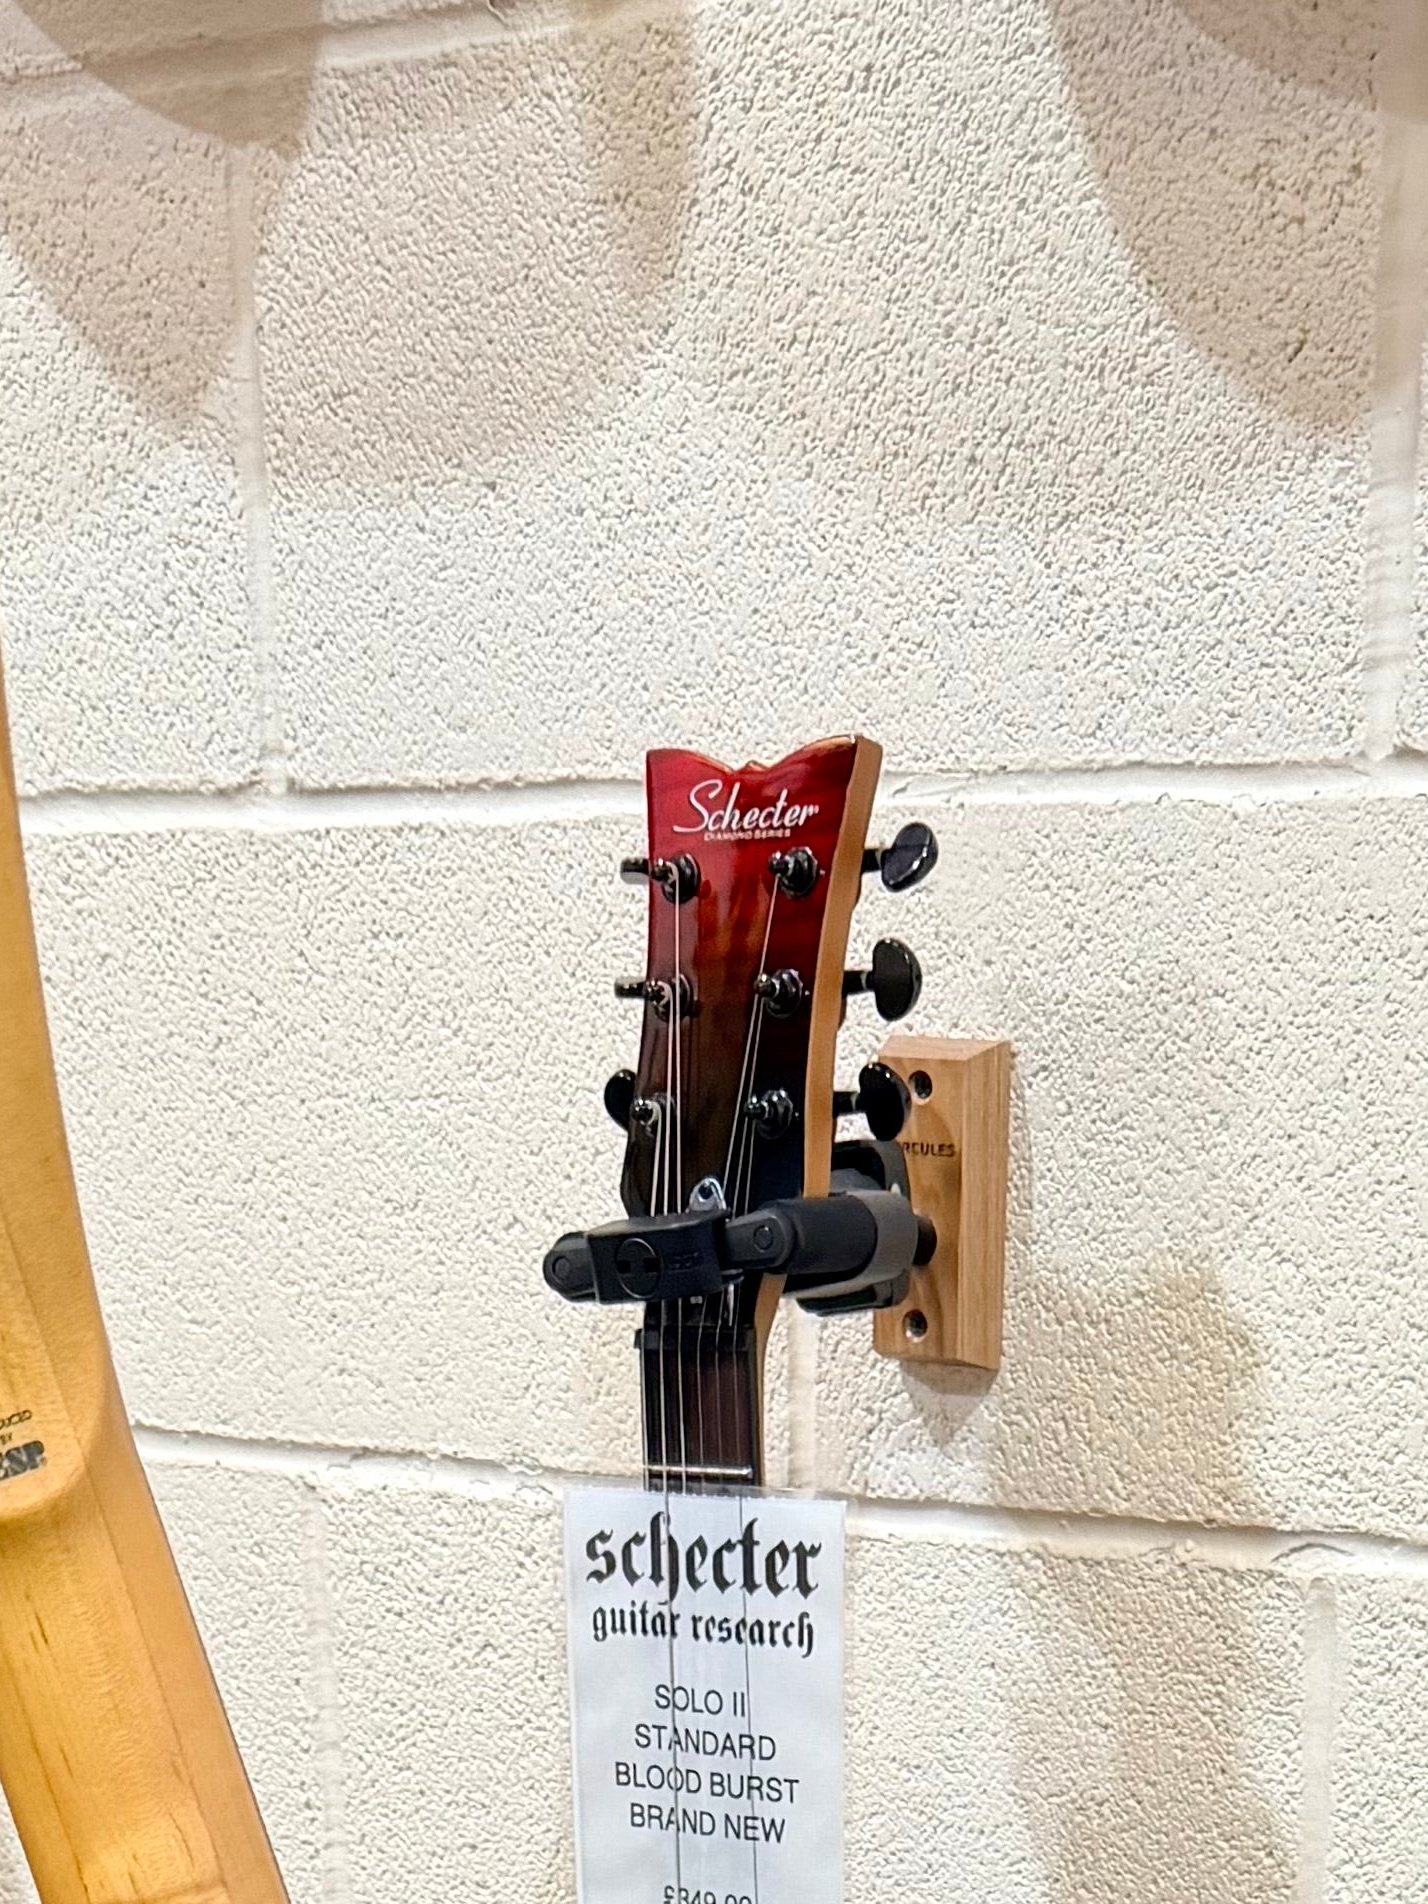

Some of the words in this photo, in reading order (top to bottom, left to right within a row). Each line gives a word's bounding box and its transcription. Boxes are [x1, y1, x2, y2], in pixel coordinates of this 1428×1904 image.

[673, 778, 818, 833] Schecter
[704, 830, 753, 841] DIAMOND
[754, 828, 791, 840] SERIES
[903, 1142, 956, 1158] RCULES
[0, 1432, 13, 1446] BY
[586, 1511, 822, 1602] schecter
[593, 1600, 680, 1642] guitar
[691, 1611, 814, 1658] research
[655, 1684, 723, 1715] SOLO
[733, 1691, 745, 1717] II
[634, 1724, 777, 1761] STANDARD
[615, 1762, 702, 1794] BLOOD
[710, 1772, 800, 1804] BURST
[630, 1803, 716, 1836] BRAND
[724, 1813, 785, 1843] NEW
